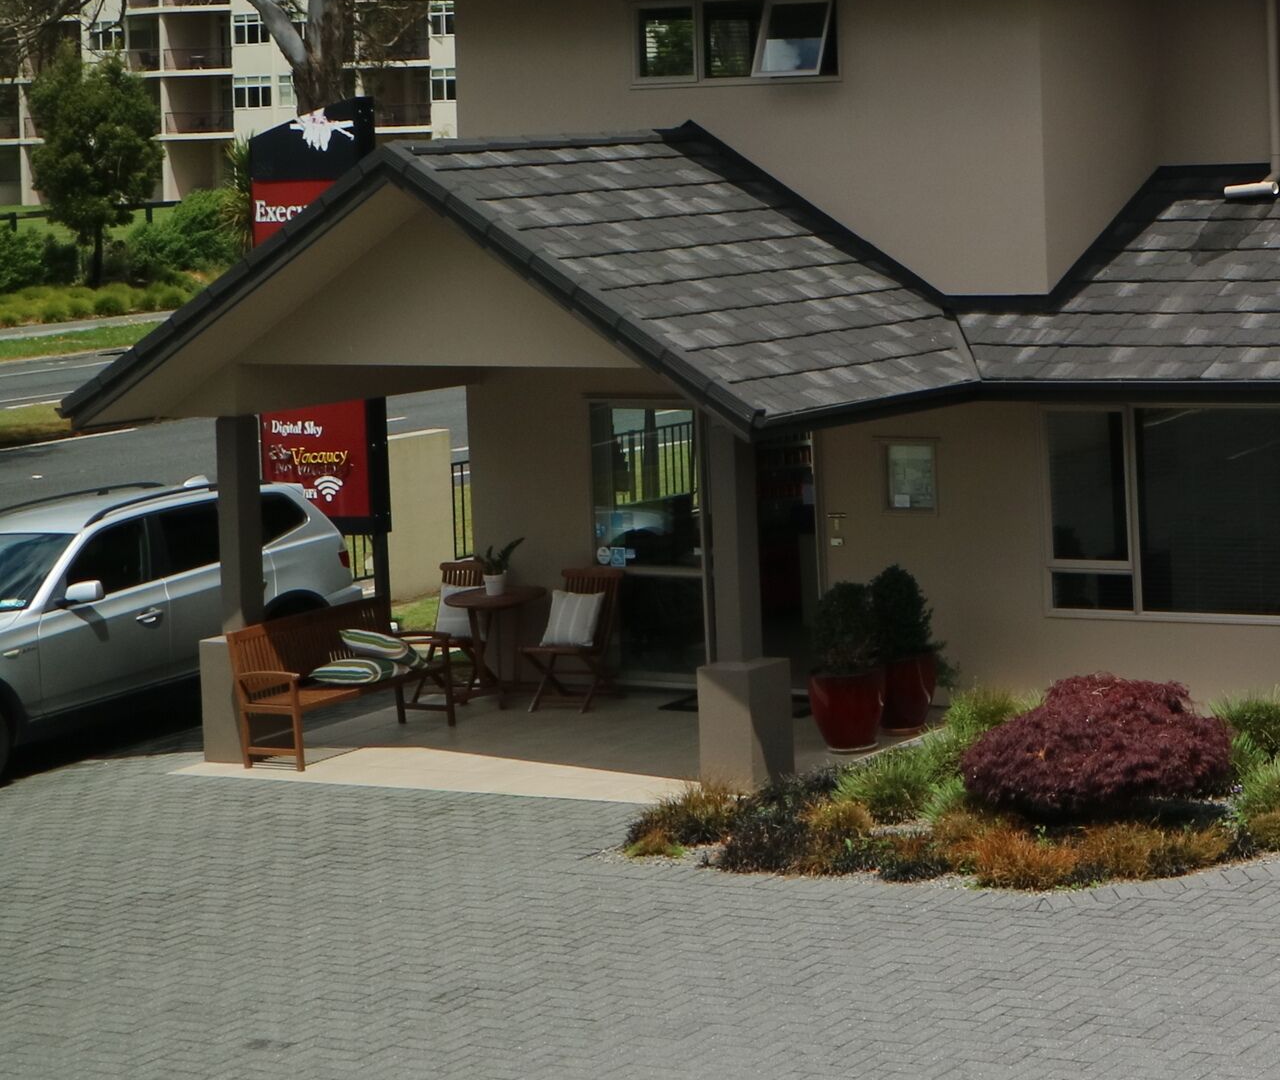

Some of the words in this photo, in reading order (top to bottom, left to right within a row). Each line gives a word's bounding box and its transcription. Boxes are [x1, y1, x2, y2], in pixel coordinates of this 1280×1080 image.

[255, 200, 307, 222] Exec
[271, 420, 302, 437] Digital
[304, 420, 322, 437] Sky
[291, 447, 348, 465] Vacancy
